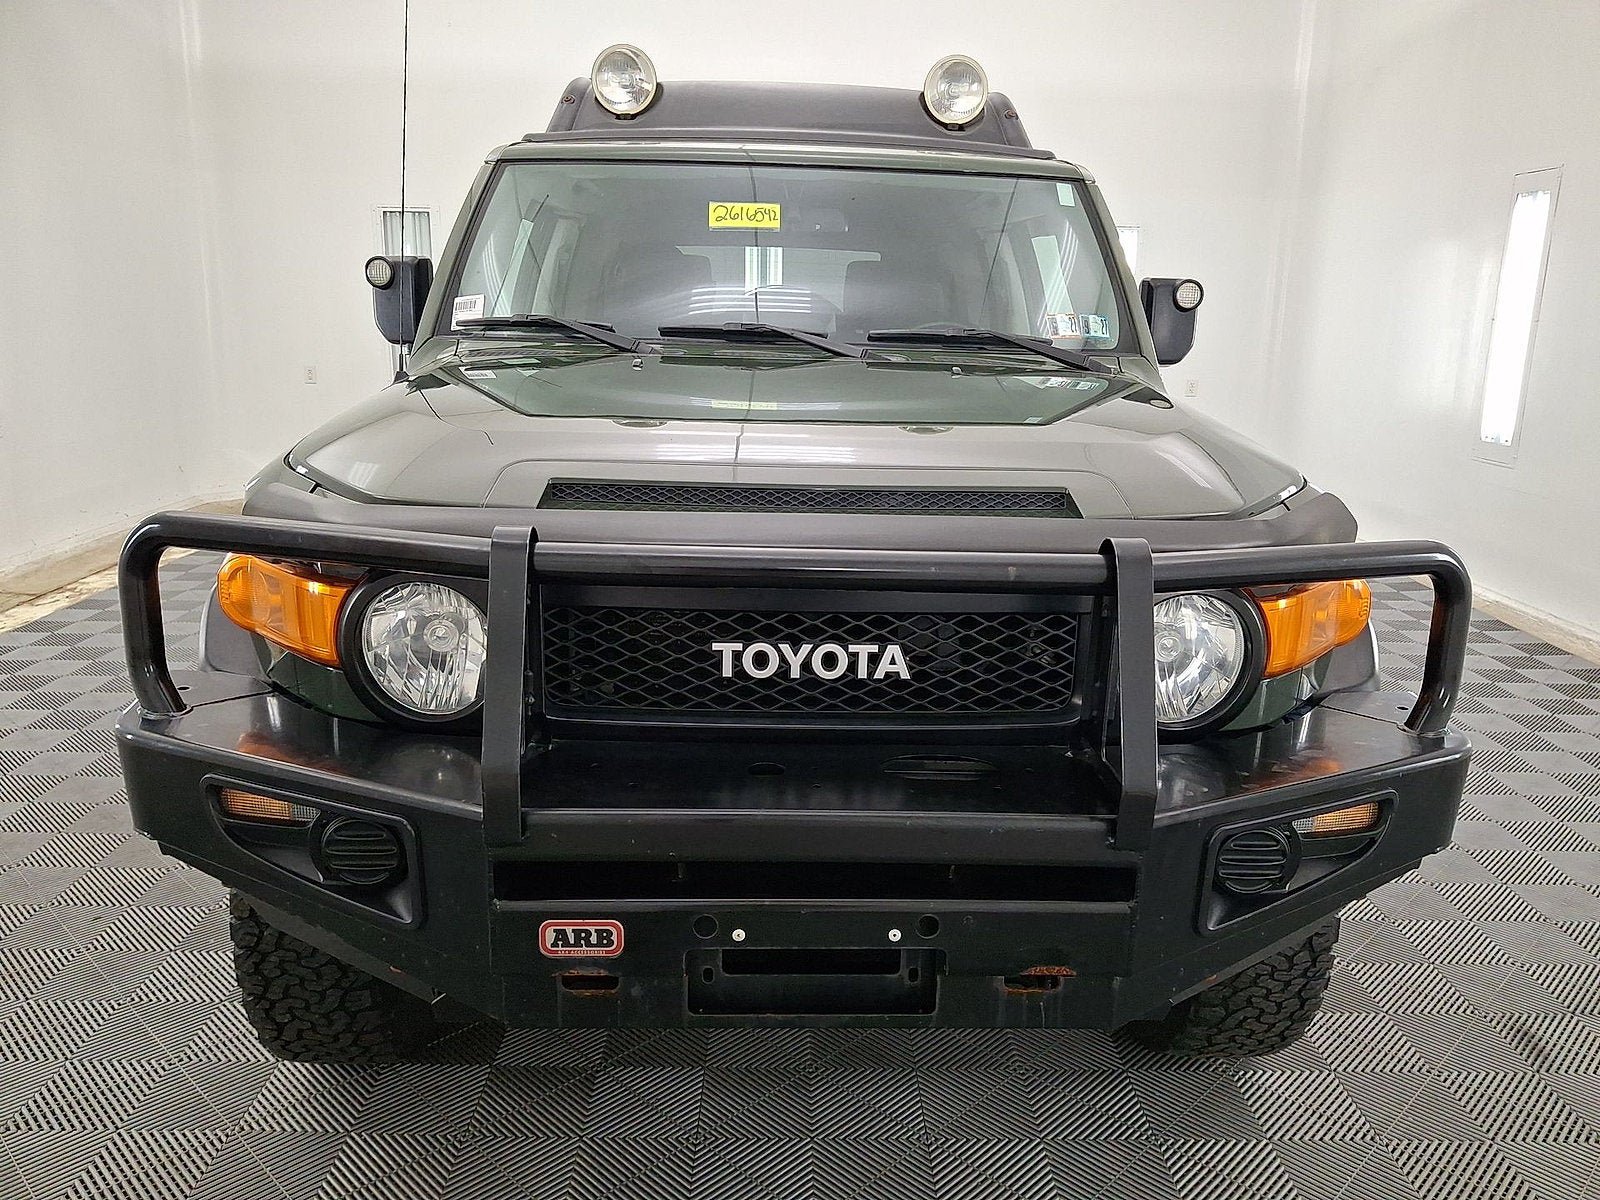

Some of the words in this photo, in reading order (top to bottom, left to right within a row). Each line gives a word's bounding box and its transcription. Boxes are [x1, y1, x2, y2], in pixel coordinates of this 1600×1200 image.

[713, 204, 779, 222] 2616542
[711, 642, 911, 680] TOYOTA
[550, 928, 615, 948] ARB
